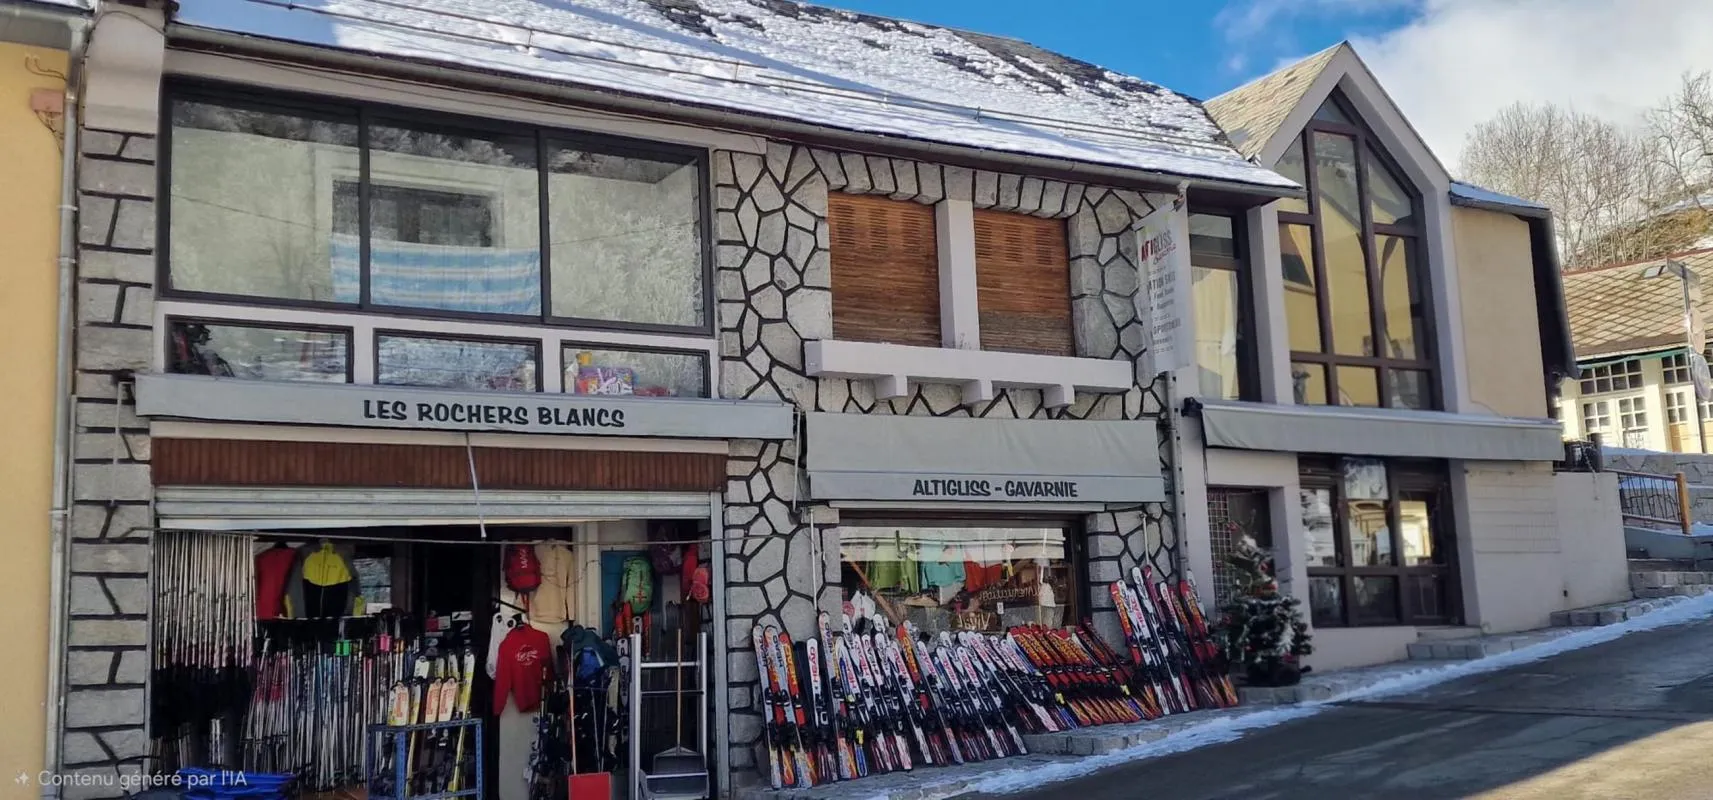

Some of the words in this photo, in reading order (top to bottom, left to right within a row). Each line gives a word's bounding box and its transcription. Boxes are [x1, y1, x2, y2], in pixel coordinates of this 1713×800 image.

[363, 399, 407, 420] LES
[416, 403, 529, 425] ROCHERS
[537, 406, 625, 428] BLANCS
[912, 479, 991, 497] ALTIGLISS
[1004, 480, 1078, 498] GAVARNIE
[771, 634, 784, 667] HEAD
[783, 643, 798, 685] HEAD
[809, 645, 818, 682] HEAD
